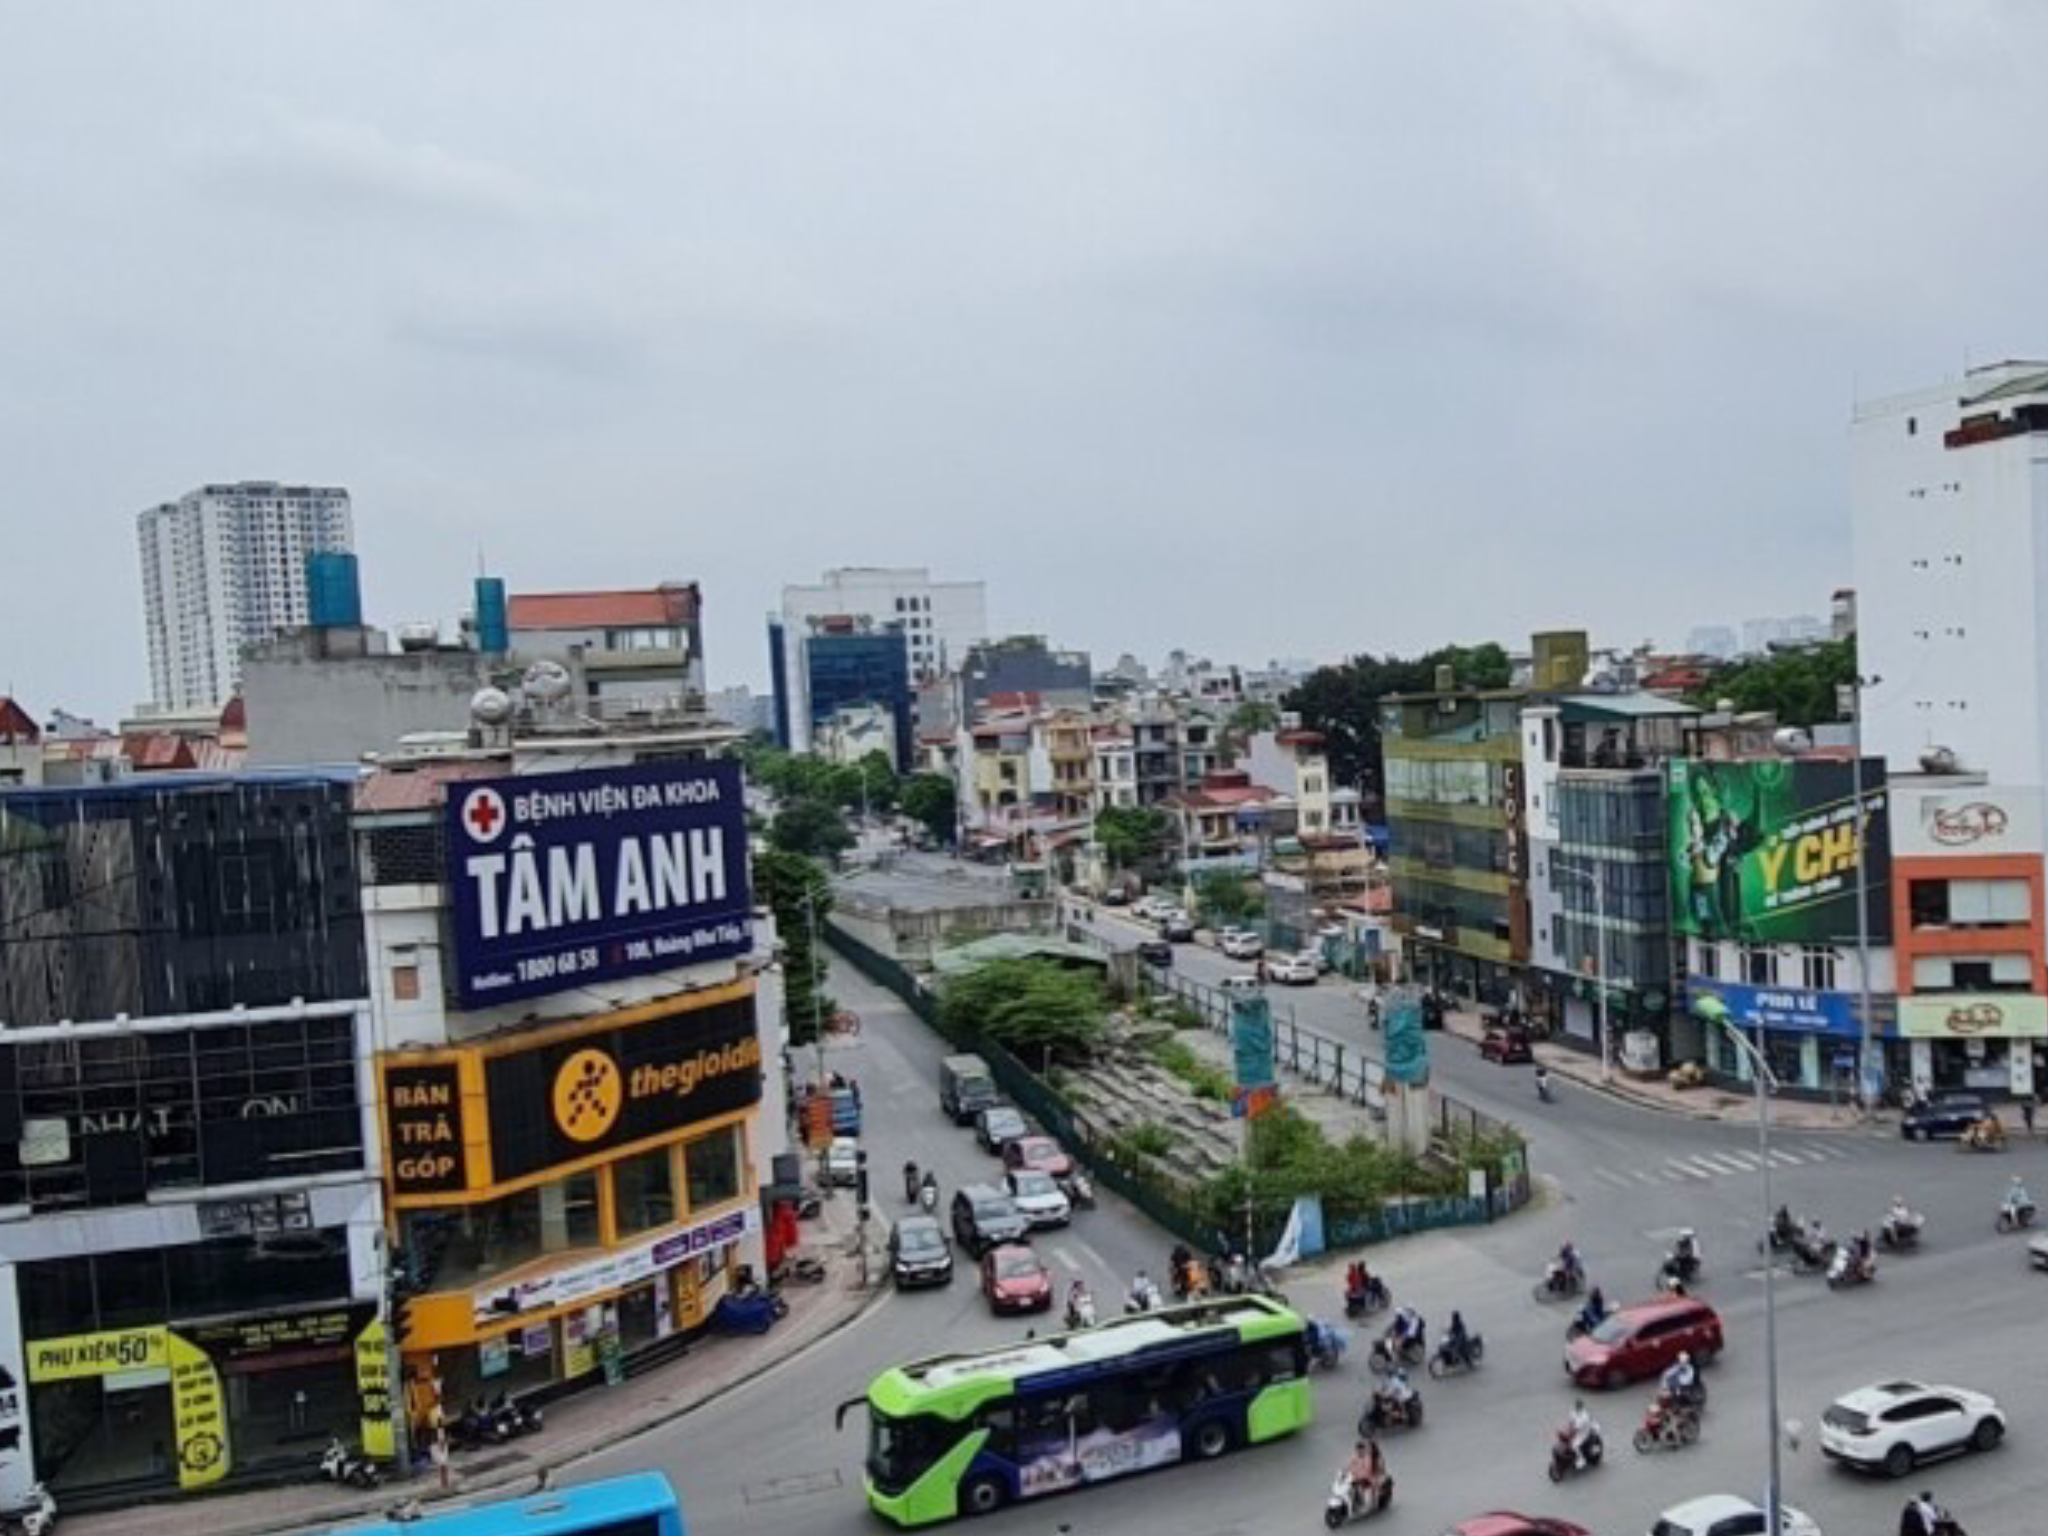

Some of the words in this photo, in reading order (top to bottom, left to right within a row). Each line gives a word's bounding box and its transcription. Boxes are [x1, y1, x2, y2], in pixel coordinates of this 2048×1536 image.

[513, 791, 575, 825] BỆNH
[578, 784, 628, 818] VIỆN
[631, 785, 662, 810] ĐA
[664, 779, 719, 806] KHOA
[466, 832, 601, 938] TÂM
[614, 826, 727, 917] ANH
[393, 1080, 449, 1108] BÁN
[397, 1151, 455, 1178] GÓP
